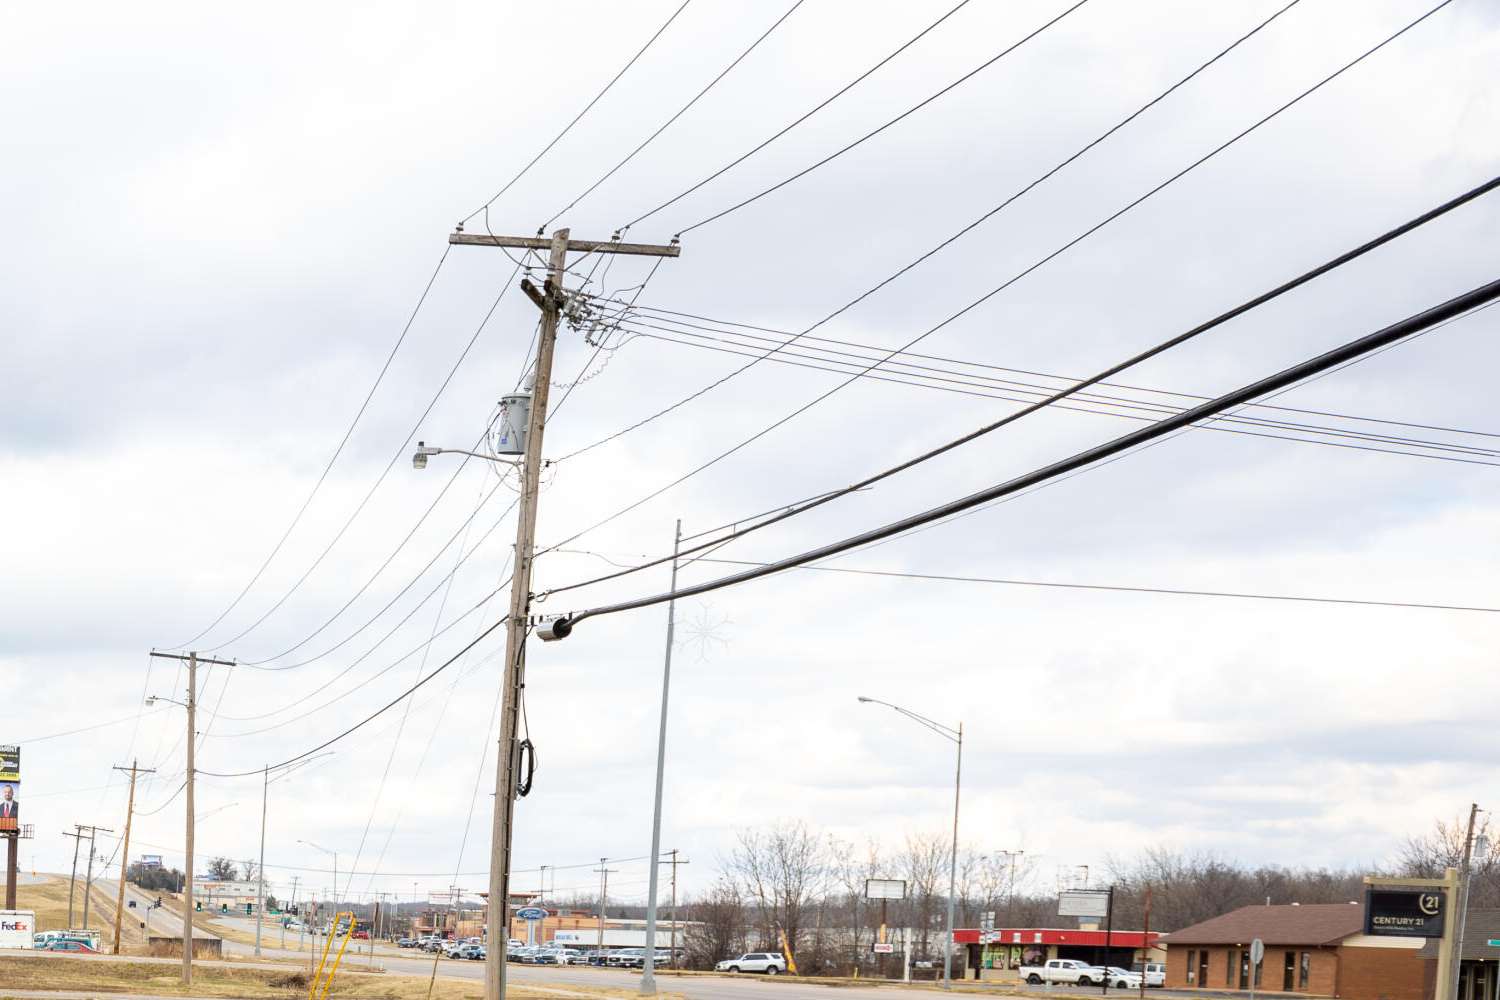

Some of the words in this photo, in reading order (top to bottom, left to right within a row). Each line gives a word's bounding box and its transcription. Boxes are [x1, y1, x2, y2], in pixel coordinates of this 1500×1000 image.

[1426, 896, 1439, 908] 21
[1373, 917, 1414, 925] CENTURY
[2, 922, 27, 930] FedEx
